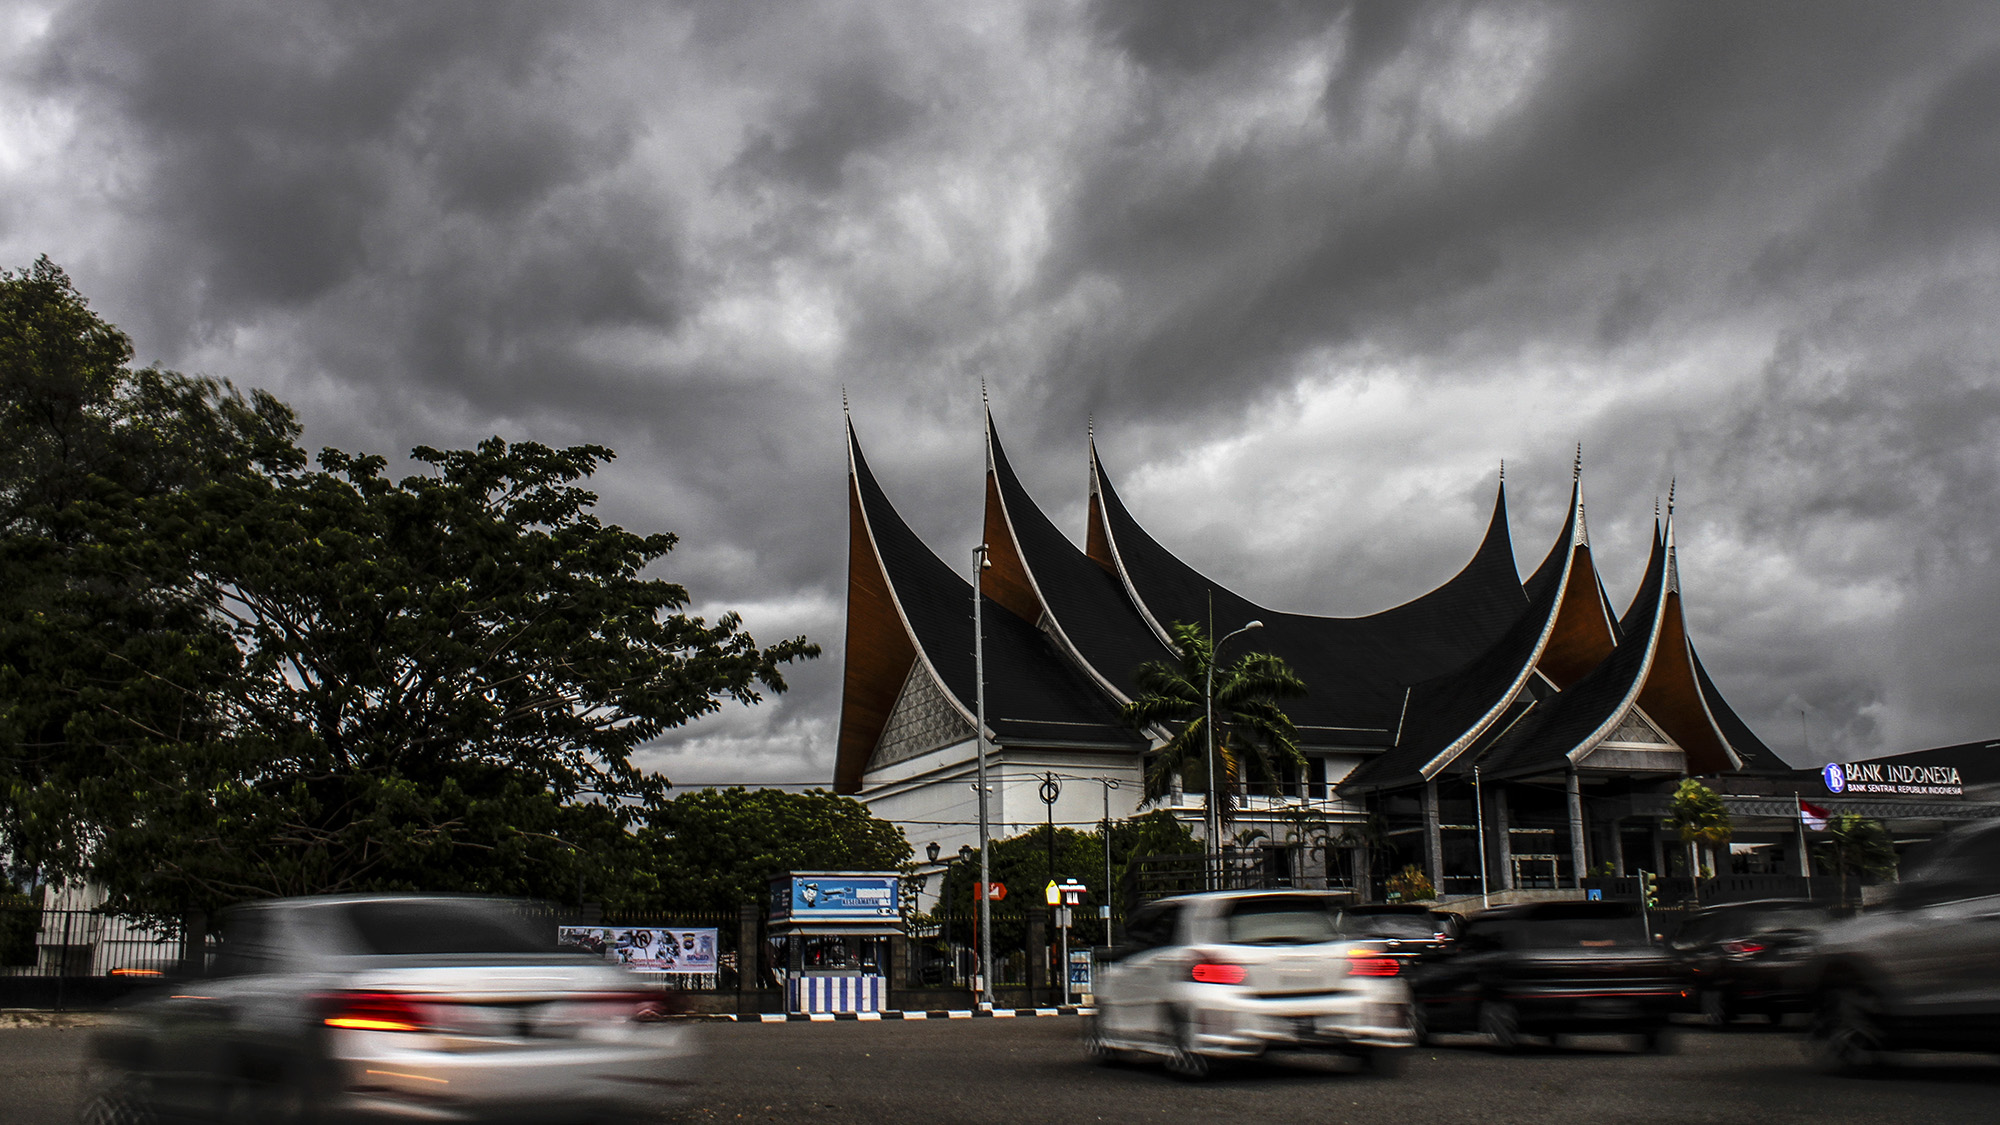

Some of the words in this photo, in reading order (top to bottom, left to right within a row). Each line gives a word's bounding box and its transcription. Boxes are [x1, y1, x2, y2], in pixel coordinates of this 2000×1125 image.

[1845, 763, 1883, 782] BANK
[1887, 764, 1962, 785] INDONESIA
[1847, 783, 1866, 792] BANK
[1868, 784, 1897, 793] SENTRAL
[1898, 785, 1928, 795] REPUBLIK
[1928, 786, 1962, 795] INDONESIA
